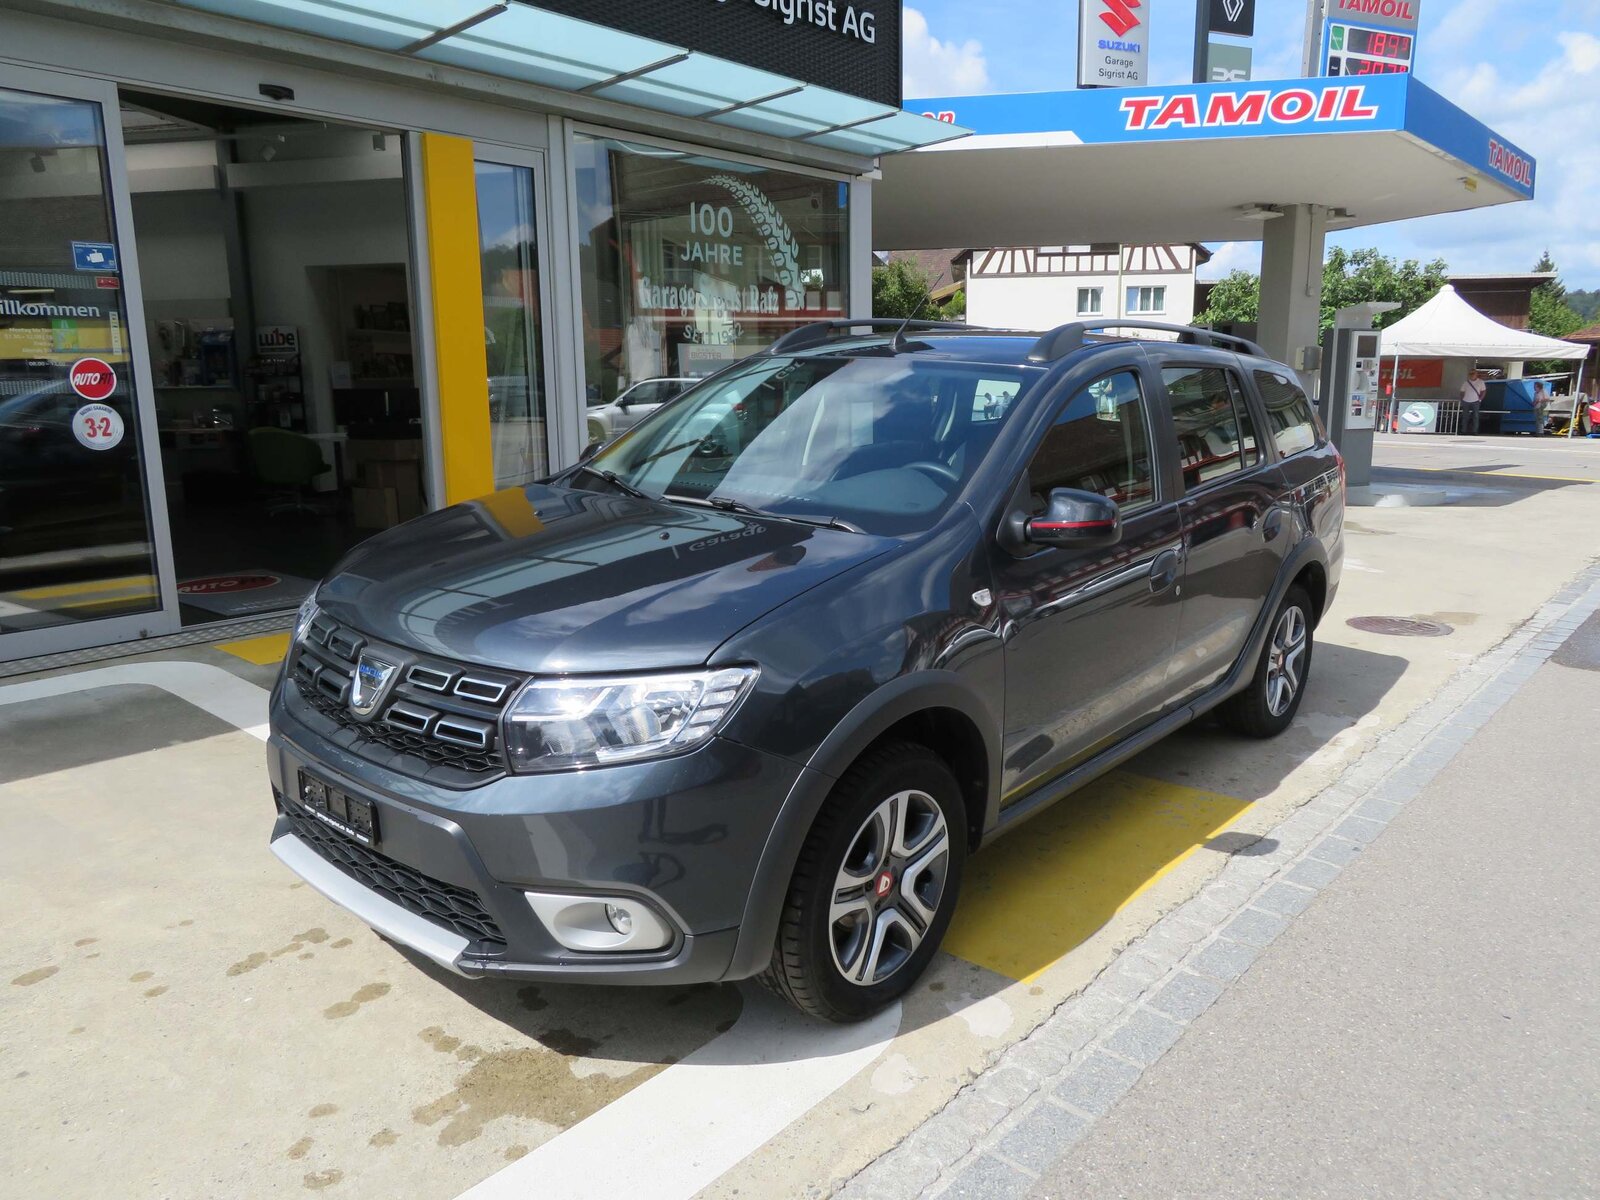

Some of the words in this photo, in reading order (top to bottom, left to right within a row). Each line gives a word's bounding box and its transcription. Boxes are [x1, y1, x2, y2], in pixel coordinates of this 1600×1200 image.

[842, 6, 876, 44] AG
[1098, 40, 1140, 53] SUZUKI
[1105, 55, 1134, 68] Garage
[1098, 68, 1125, 79] Sigrist
[1126, 71, 1138, 80] AG
[1119, 85, 1379, 131] TAMOIL
[1488, 138, 1531, 188] TAMOIL
[690, 201, 733, 238] 100
[680, 240, 743, 266] JAHRE
[0, 299, 101, 318] illkommen
[639, 276, 695, 317] Garage
[750, 284, 779, 315] Rafz
